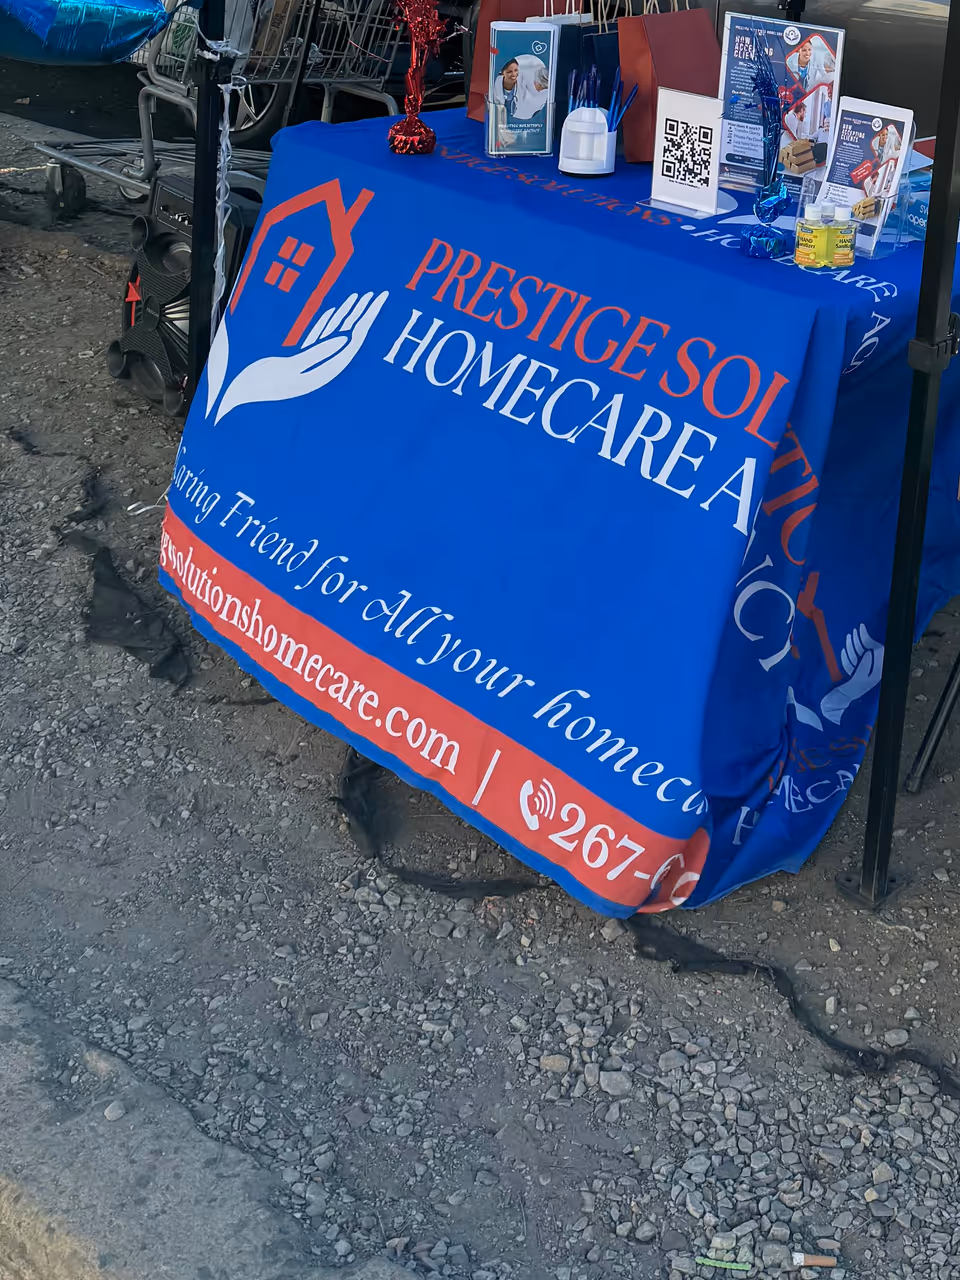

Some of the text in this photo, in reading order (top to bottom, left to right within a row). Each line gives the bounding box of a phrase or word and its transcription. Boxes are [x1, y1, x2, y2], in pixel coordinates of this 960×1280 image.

[382, 308, 719, 502] HOMECARE
[404, 237, 670, 380] PRESTIGE
[219, 490, 319, 572] Friend
[293, 555, 369, 604] for
[362, 589, 454, 646] All
[415, 632, 536, 698] your
